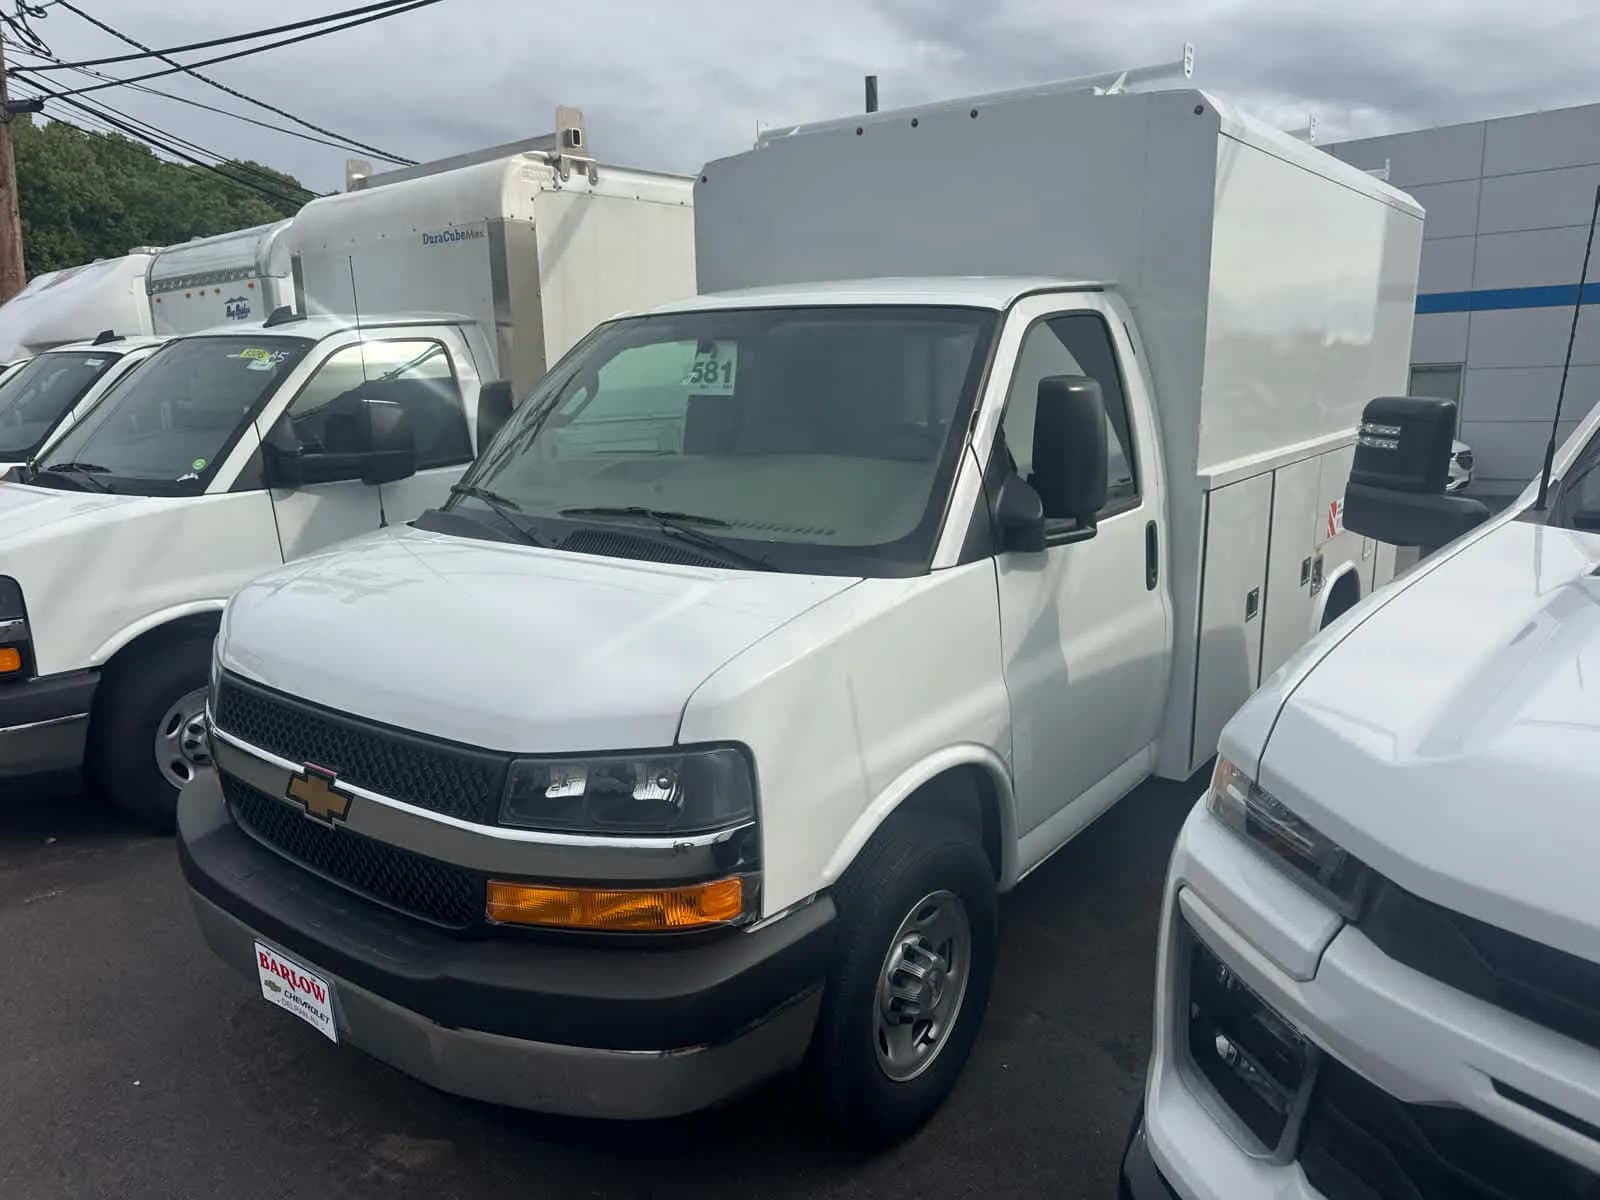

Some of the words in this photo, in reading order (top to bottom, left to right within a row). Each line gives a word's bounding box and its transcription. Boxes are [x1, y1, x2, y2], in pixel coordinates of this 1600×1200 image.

[691, 360, 732, 384] 581
[258, 951, 326, 1004] BARLOW
[284, 990, 330, 1024] CHEVROLET
